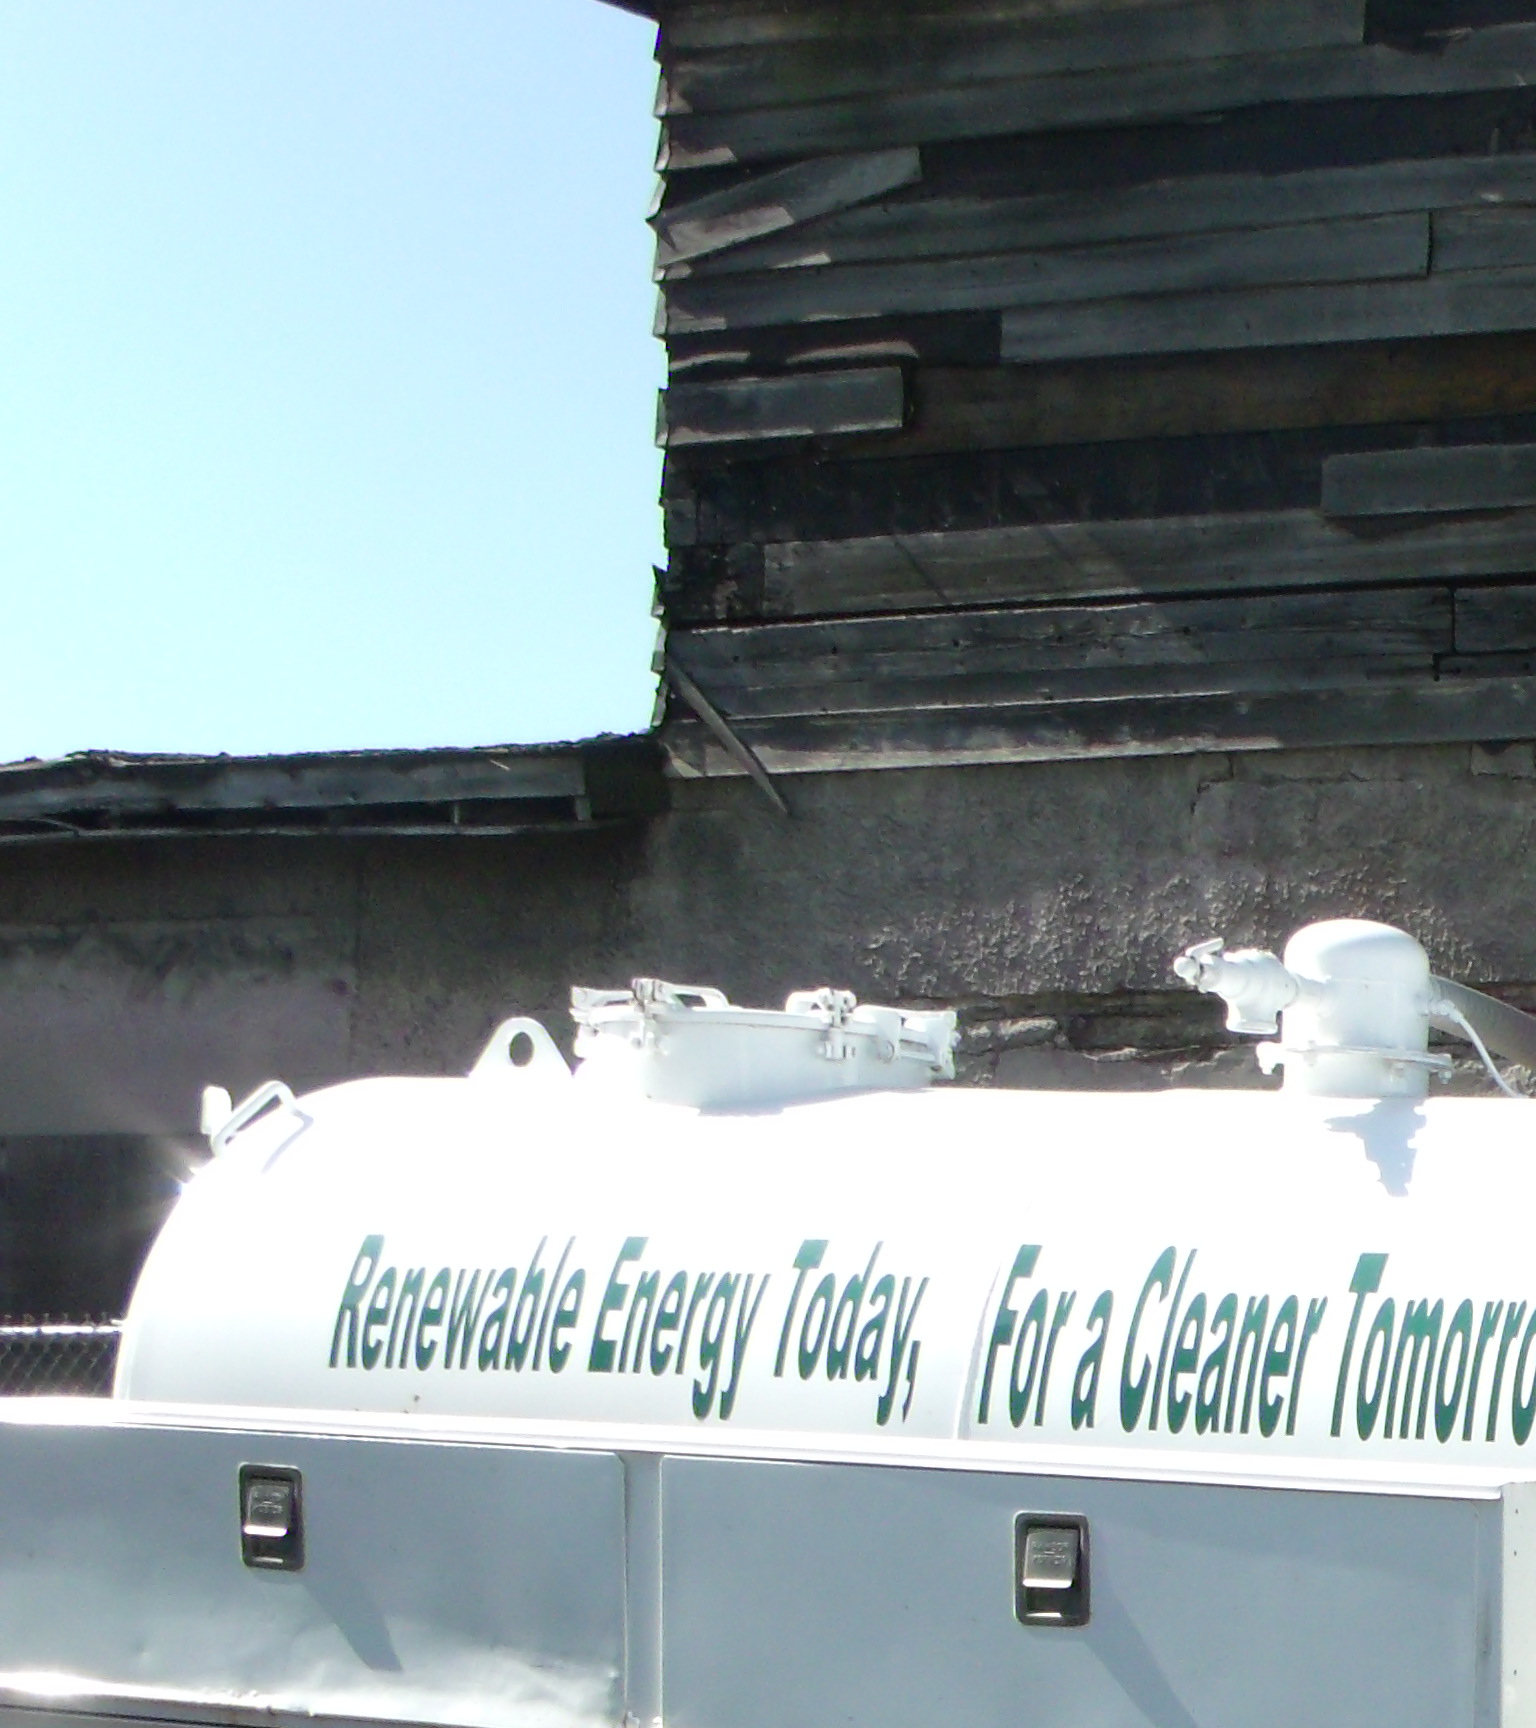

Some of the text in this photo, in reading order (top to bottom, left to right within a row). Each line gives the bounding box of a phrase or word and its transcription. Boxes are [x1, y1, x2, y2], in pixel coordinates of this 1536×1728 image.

[329, 1234, 585, 1373] Renewable
[587, 1236, 771, 1421] Energy
[773, 1238, 930, 1426] Today,
[977, 1243, 1077, 1429] For
[1071, 1289, 1114, 1431] a
[1119, 1245, 1328, 1438] Cleaner
